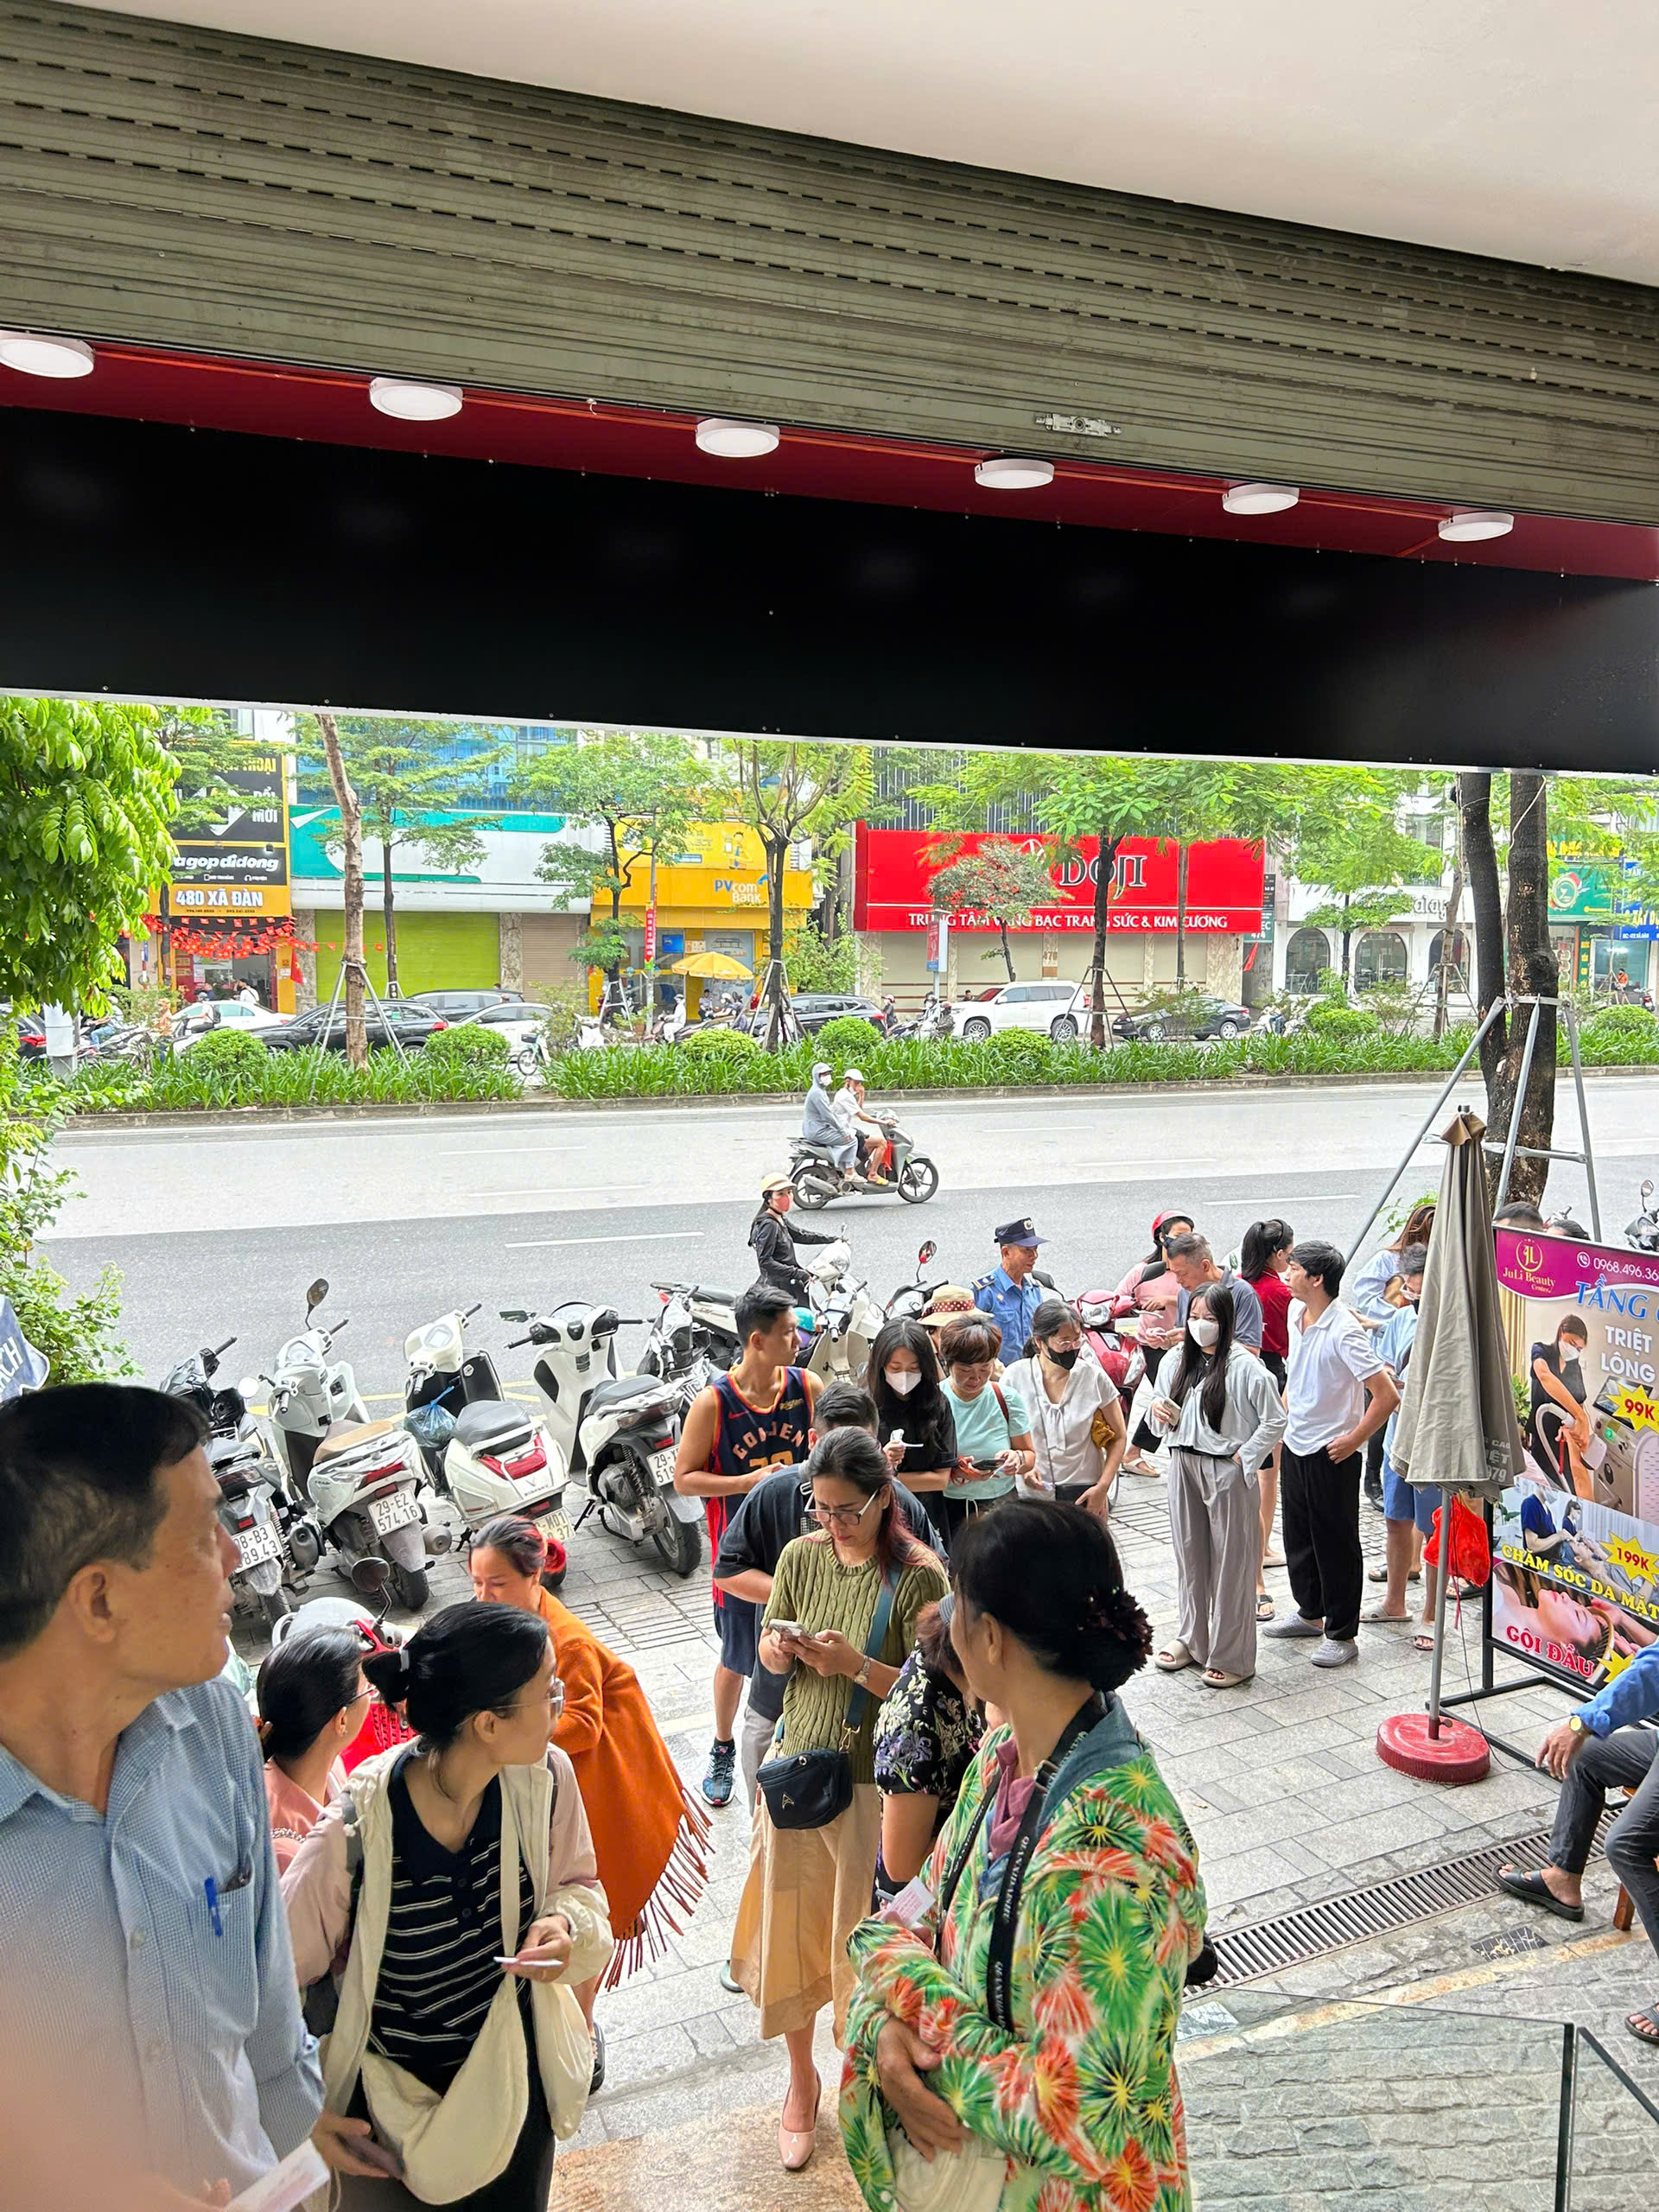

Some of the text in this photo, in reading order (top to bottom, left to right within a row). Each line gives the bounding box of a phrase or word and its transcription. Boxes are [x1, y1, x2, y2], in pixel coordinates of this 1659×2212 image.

[1059, 855, 1147, 900] DOJI
[175, 888, 264, 906] 480 XÃ ĐÀN
[733, 892, 761, 904] Bank
[1035, 915, 1062, 930] BẠC
[1113, 912, 1140, 928] SỨC
[1141, 916, 1152, 928] &
[1154, 915, 1178, 928] KIM
[1184, 914, 1228, 930] CƯƠNG
[1503, 1267, 1556, 1287] JuLi Beauty
[1593, 1256, 1659, 1281] 0968.496.36
[1605, 1325, 1653, 1356] TRIỆT
[1601, 1351, 1656, 1383] LÔNG
[1624, 1397, 1656, 1421] 99K
[376, 1492, 410, 1517] 29-E2
[378, 1504, 417, 1532] 574.16
[1617, 1548, 1649, 1572] 199K
[1502, 1544, 1659, 1619] CHĂM SÓC DA MẶT
[1506, 1625, 1595, 1677] GỘI ĐẦU
